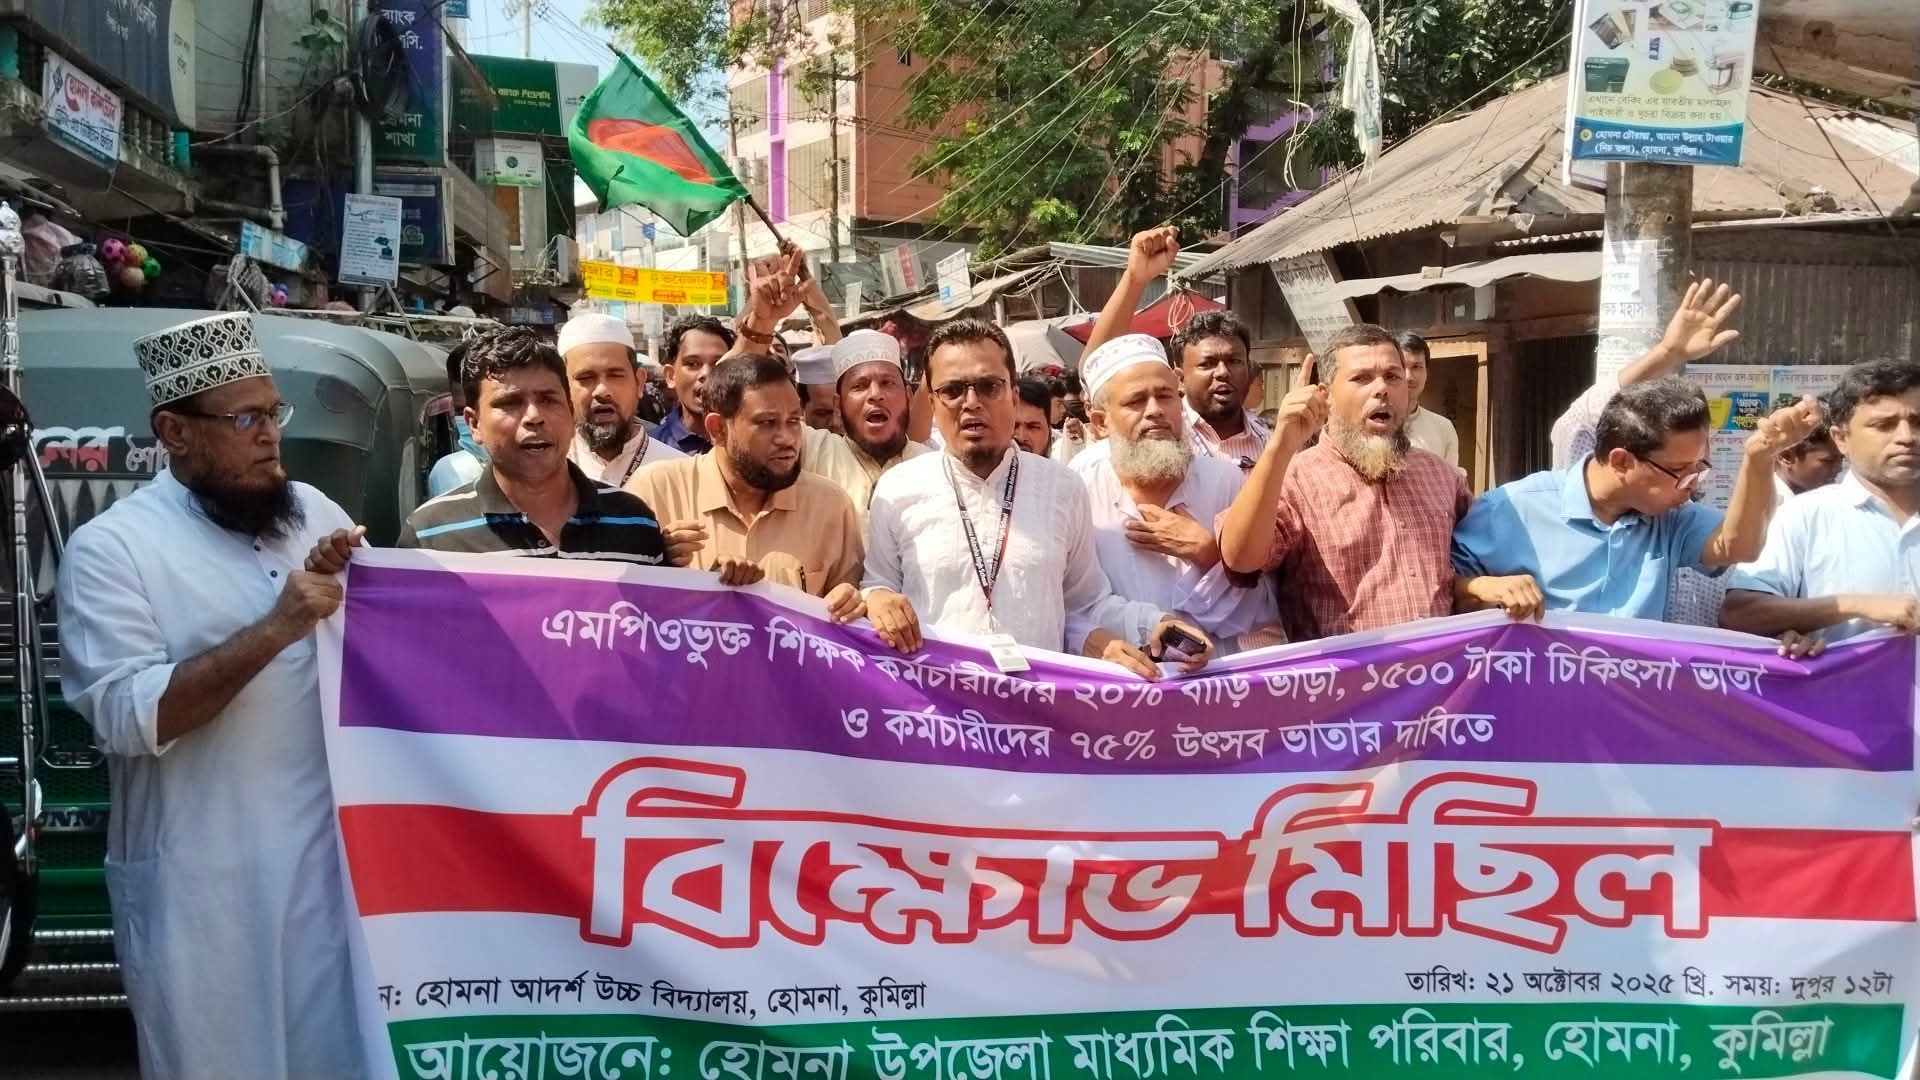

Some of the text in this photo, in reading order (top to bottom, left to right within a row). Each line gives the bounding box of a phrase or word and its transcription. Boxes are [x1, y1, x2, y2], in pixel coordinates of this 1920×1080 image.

[385, 131, 416, 147] শাখা
[541, 601, 755, 670] এমপিওভুক্ত
[765, 615, 866, 673] শিক্ষক
[868, 653, 1056, 706] কর্মচারীদের
[1074, 682, 1163, 711] ২০%
[1260, 663, 1346, 702] ভাড়া,
[1362, 661, 1454, 692] ১৫০০
[1464, 643, 1535, 685] টাকা
[1545, 641, 1680, 692] চিকিৎসা
[1689, 659, 1768, 696] ভাতা
[841, 705, 1496, 761] ও কর্মচারীদের ৭৫% উৎসব ভাতার দাবিতে
[575, 754, 1720, 952] বিক্ষোভ মিছিল
[378, 970, 928, 1020] ন: হোমনা আদর্শ উচ্চ বিদ্যালয়, হোমনা, কুমিল্লা
[1405, 965, 1894, 1000] তারিখ: ২১ অক্টোবর ২০২৫ খ্রি. সময়: দুপুর ১২টা
[403, 1007, 1835, 1080] আয়োজনে: হোমনা উপজেলা মাধ্যমিক শিক্ষা পরিবার, হোমনা, কুমিল্লা
